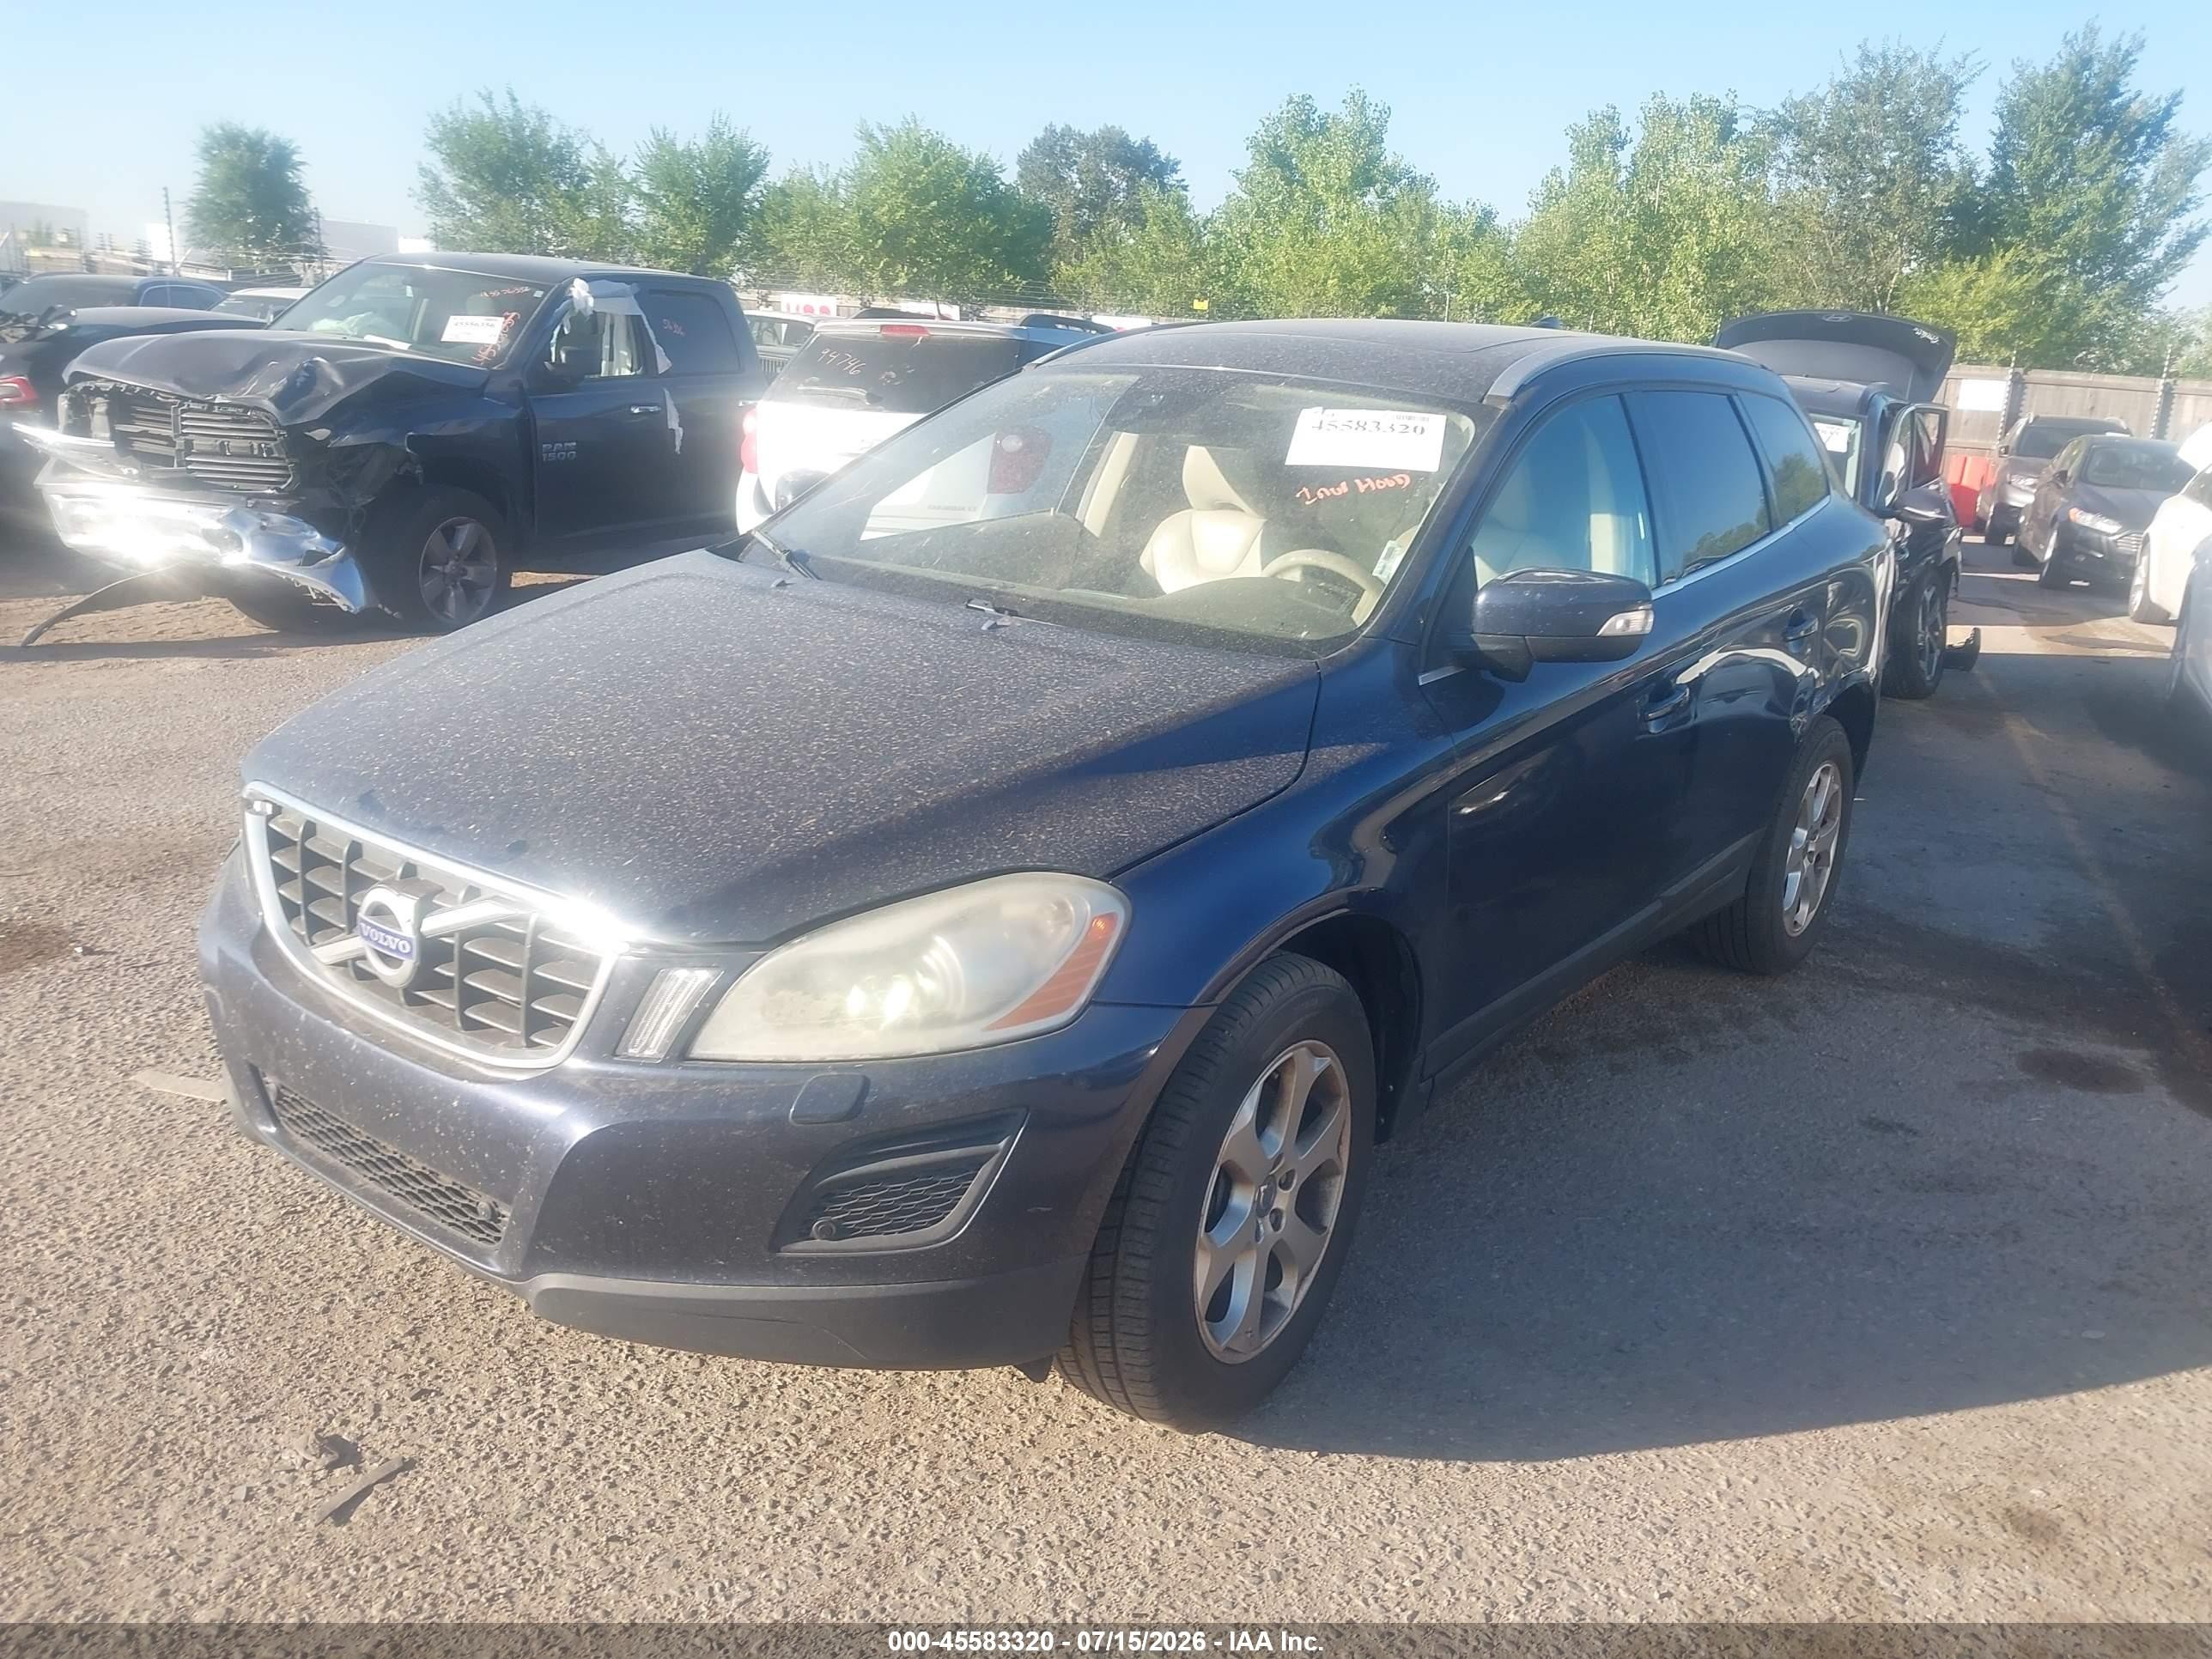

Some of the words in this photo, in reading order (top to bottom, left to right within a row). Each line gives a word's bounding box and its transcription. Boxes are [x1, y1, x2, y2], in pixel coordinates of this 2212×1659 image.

[1312, 419, 1425, 435] 45583320
[542, 452, 576, 461] 1500
[360, 922, 411, 953] VOLVO
